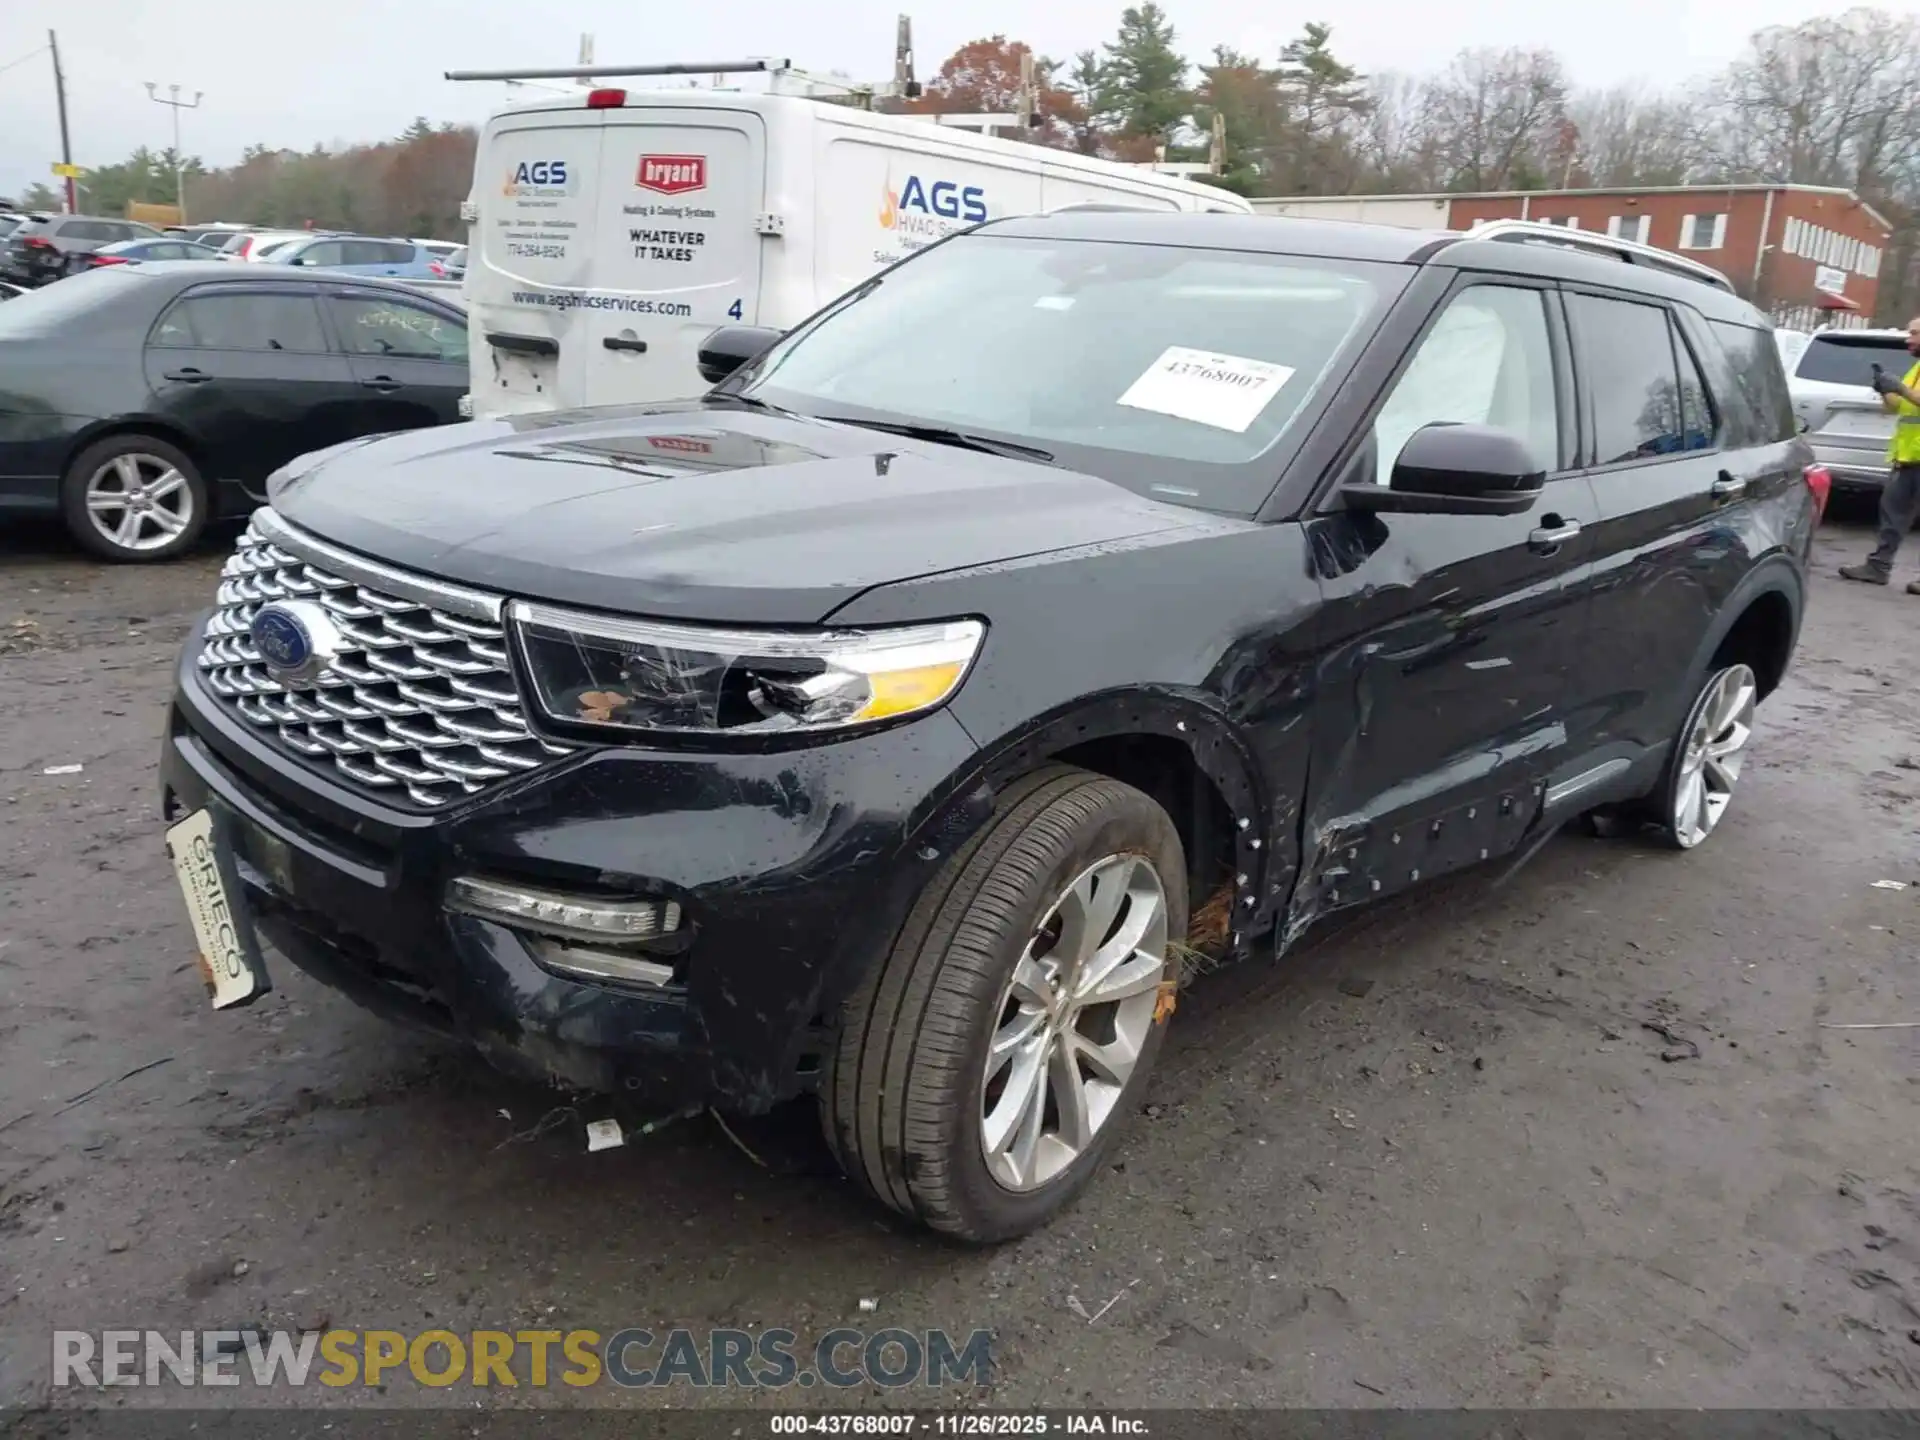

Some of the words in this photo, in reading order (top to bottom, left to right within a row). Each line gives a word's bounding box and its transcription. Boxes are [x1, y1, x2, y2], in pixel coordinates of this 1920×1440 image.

[513, 160, 568, 185] AGS
[645, 160, 699, 186] bryant
[899, 174, 988, 222] AGS
[684, 206, 716, 219] Systems
[628, 228, 706, 246] WHATEVER
[898, 215, 935, 236] HVAC
[634, 246, 648, 260] IT
[650, 246, 694, 263] TAKES
[727, 297, 743, 321] 4
[192, 834, 241, 979] GRIECO
